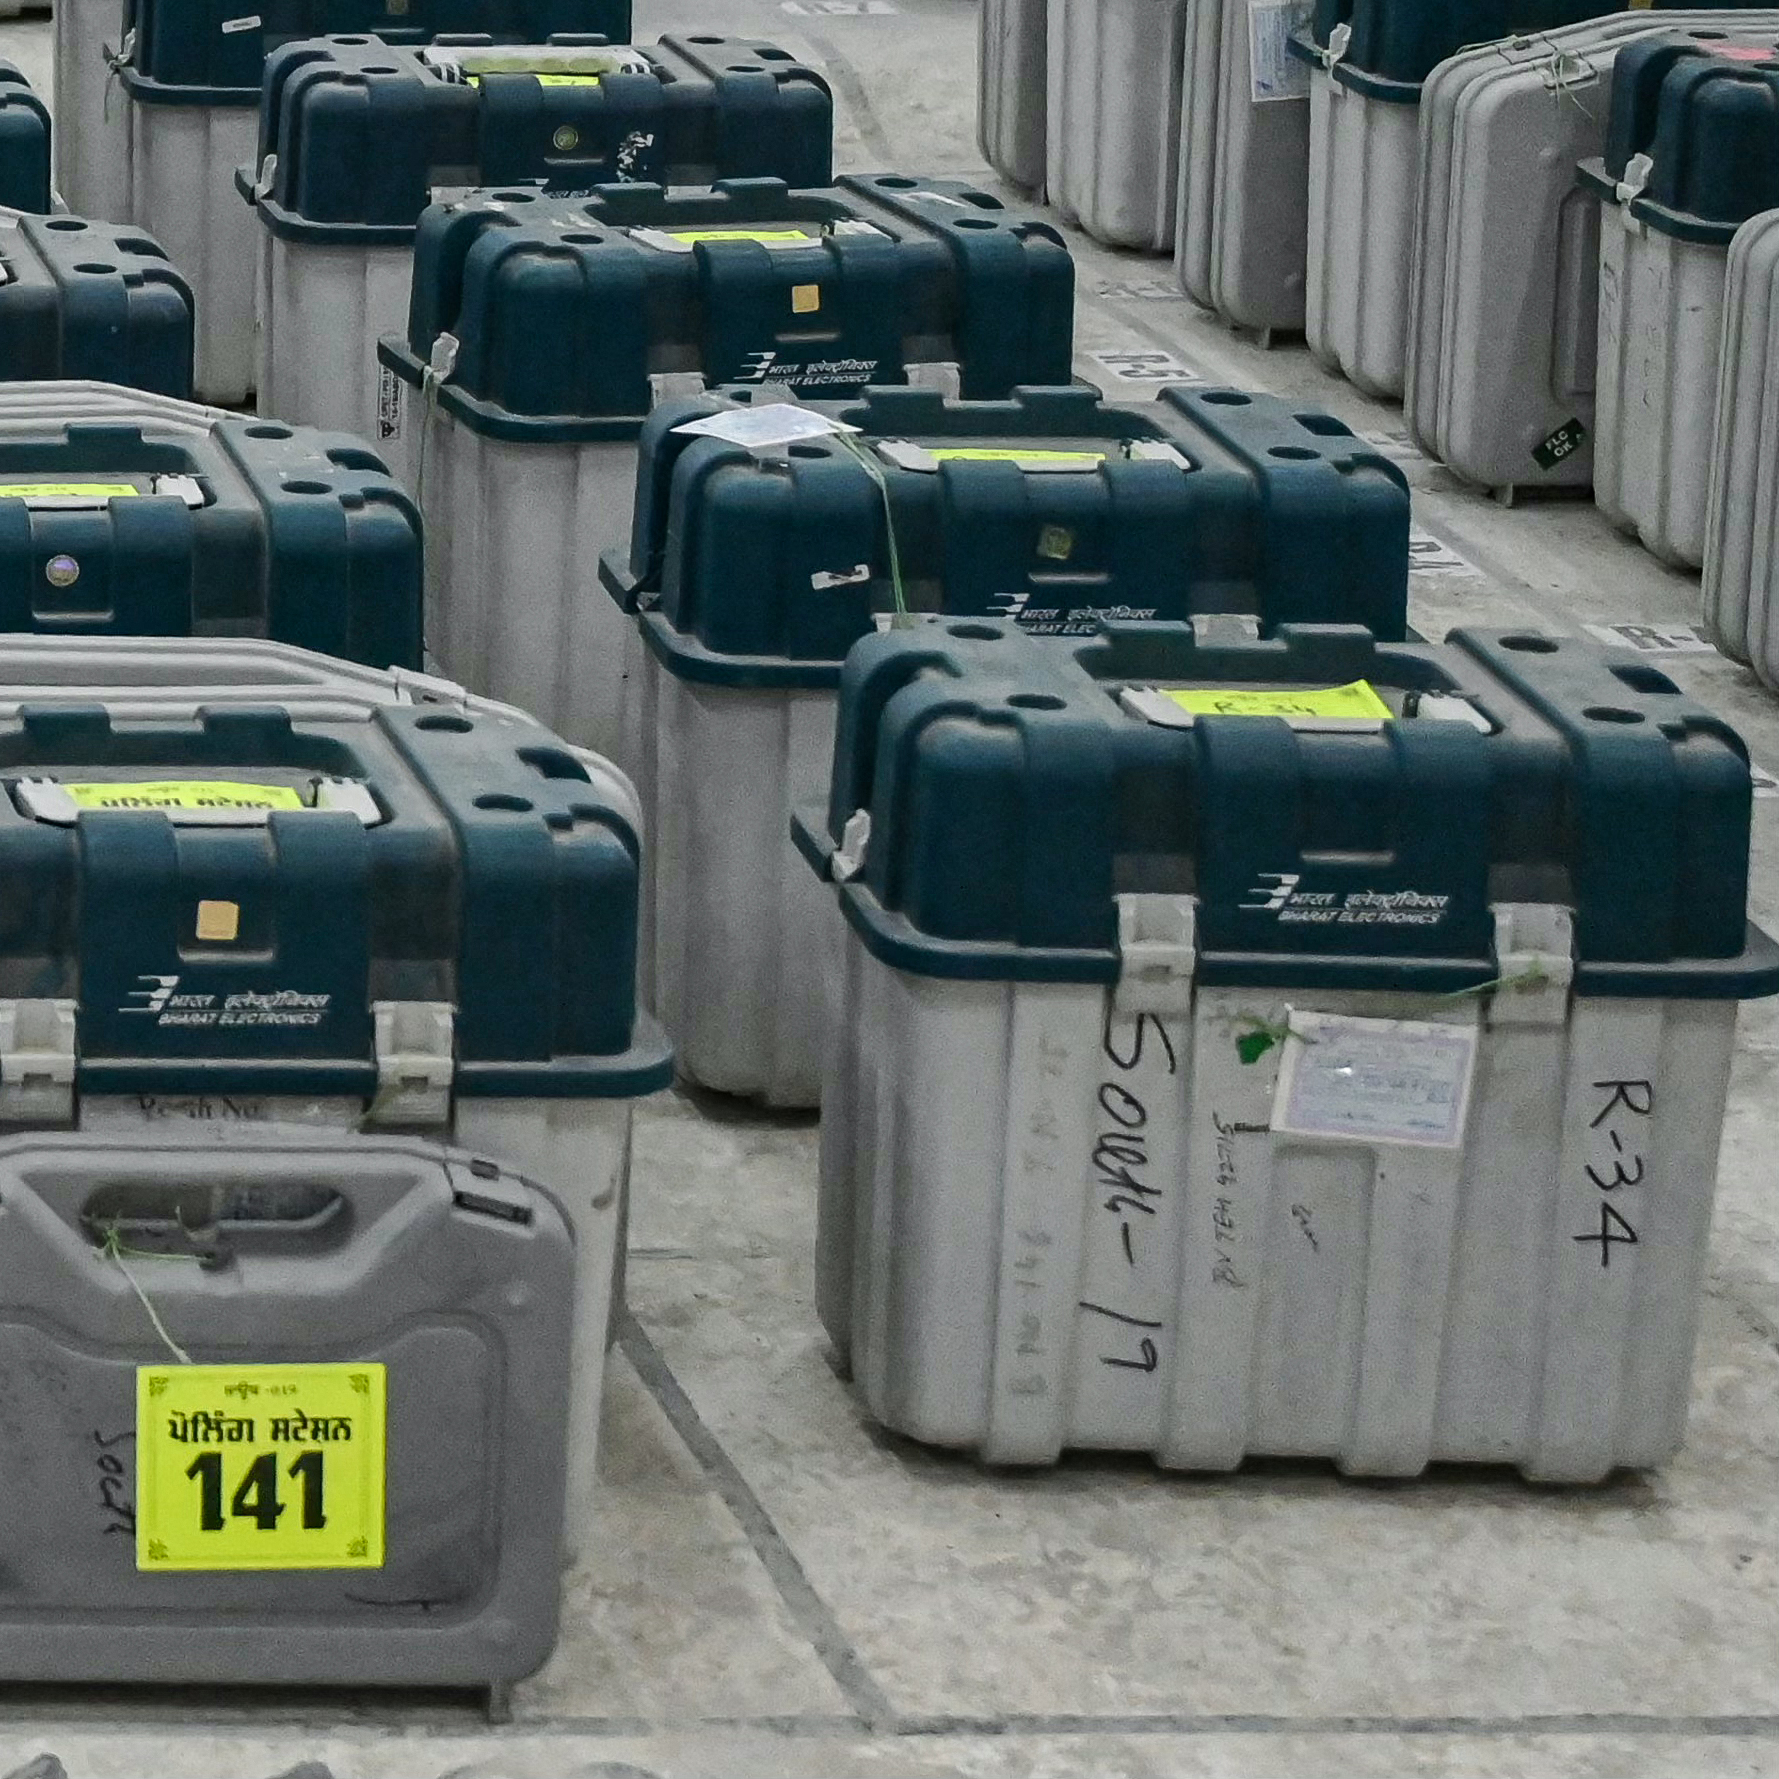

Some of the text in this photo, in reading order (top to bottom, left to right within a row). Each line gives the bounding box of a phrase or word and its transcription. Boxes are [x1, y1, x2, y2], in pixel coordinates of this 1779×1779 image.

[1278, 910, 1441, 924] BHARAT ELECTRONICS
[159, 1012, 322, 1025] BHARAT ELECTRONICS
[1573, 1080, 1652, 1267] R-34
[168, 1408, 352, 1444] ਪੋਲਿੰਗ ਸਟੇਸ਼ਨ
[186, 1450, 326, 1531] 141
